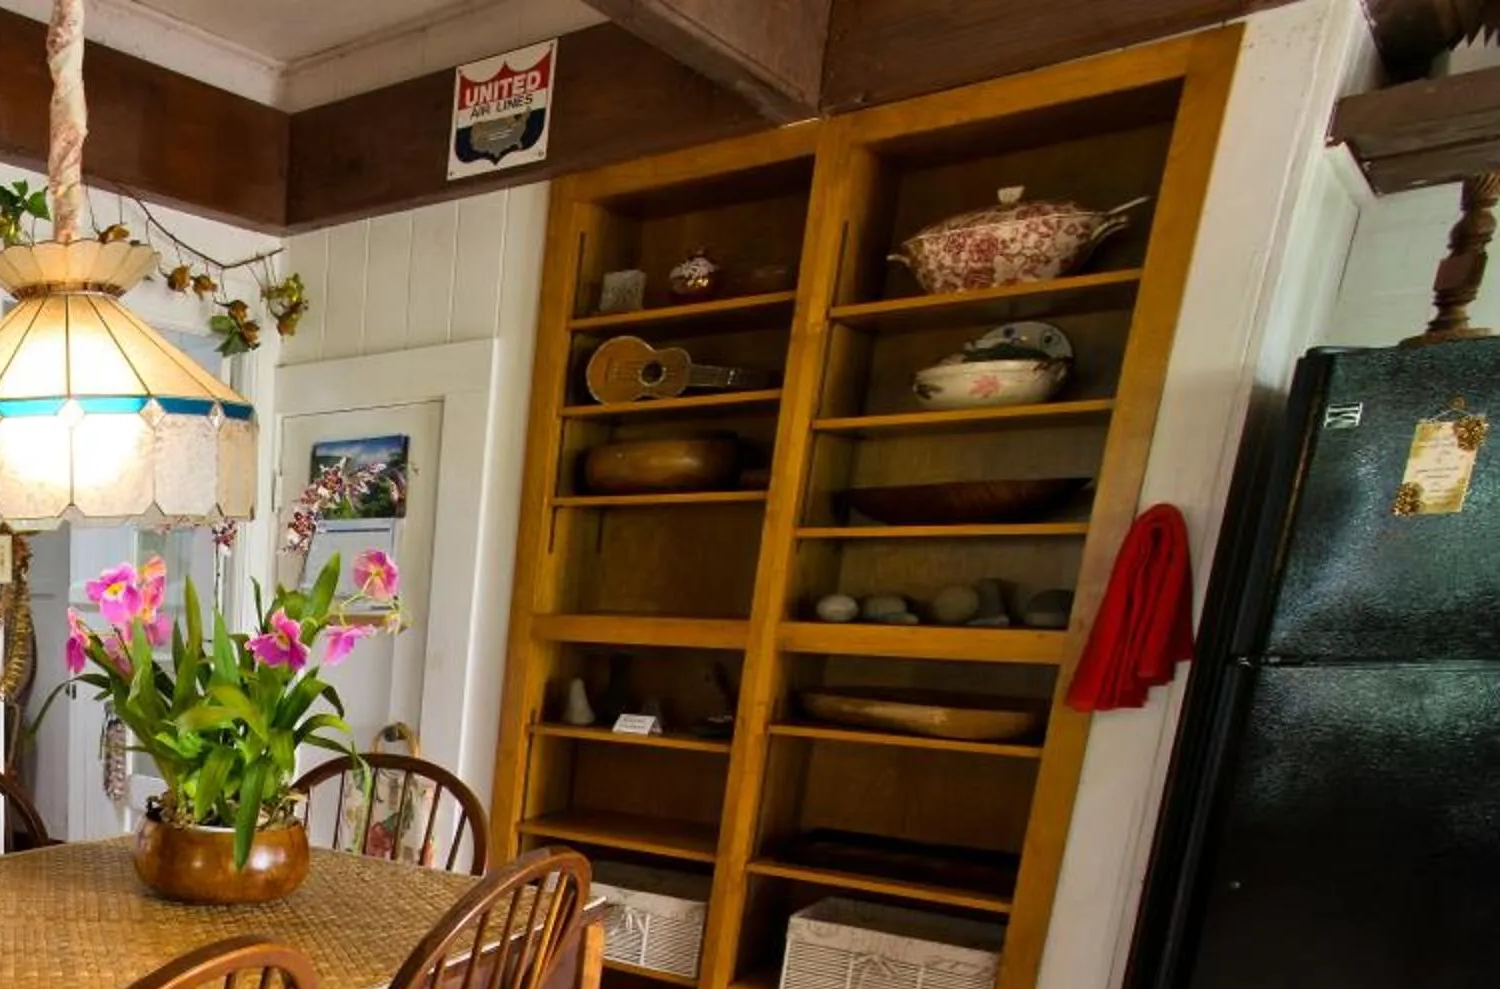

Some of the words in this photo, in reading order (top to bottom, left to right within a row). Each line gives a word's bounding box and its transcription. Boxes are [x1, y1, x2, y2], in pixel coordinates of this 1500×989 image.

[465, 71, 541, 107] UNITED
[471, 102, 490, 118] AIR
[496, 94, 533, 113] LINES
